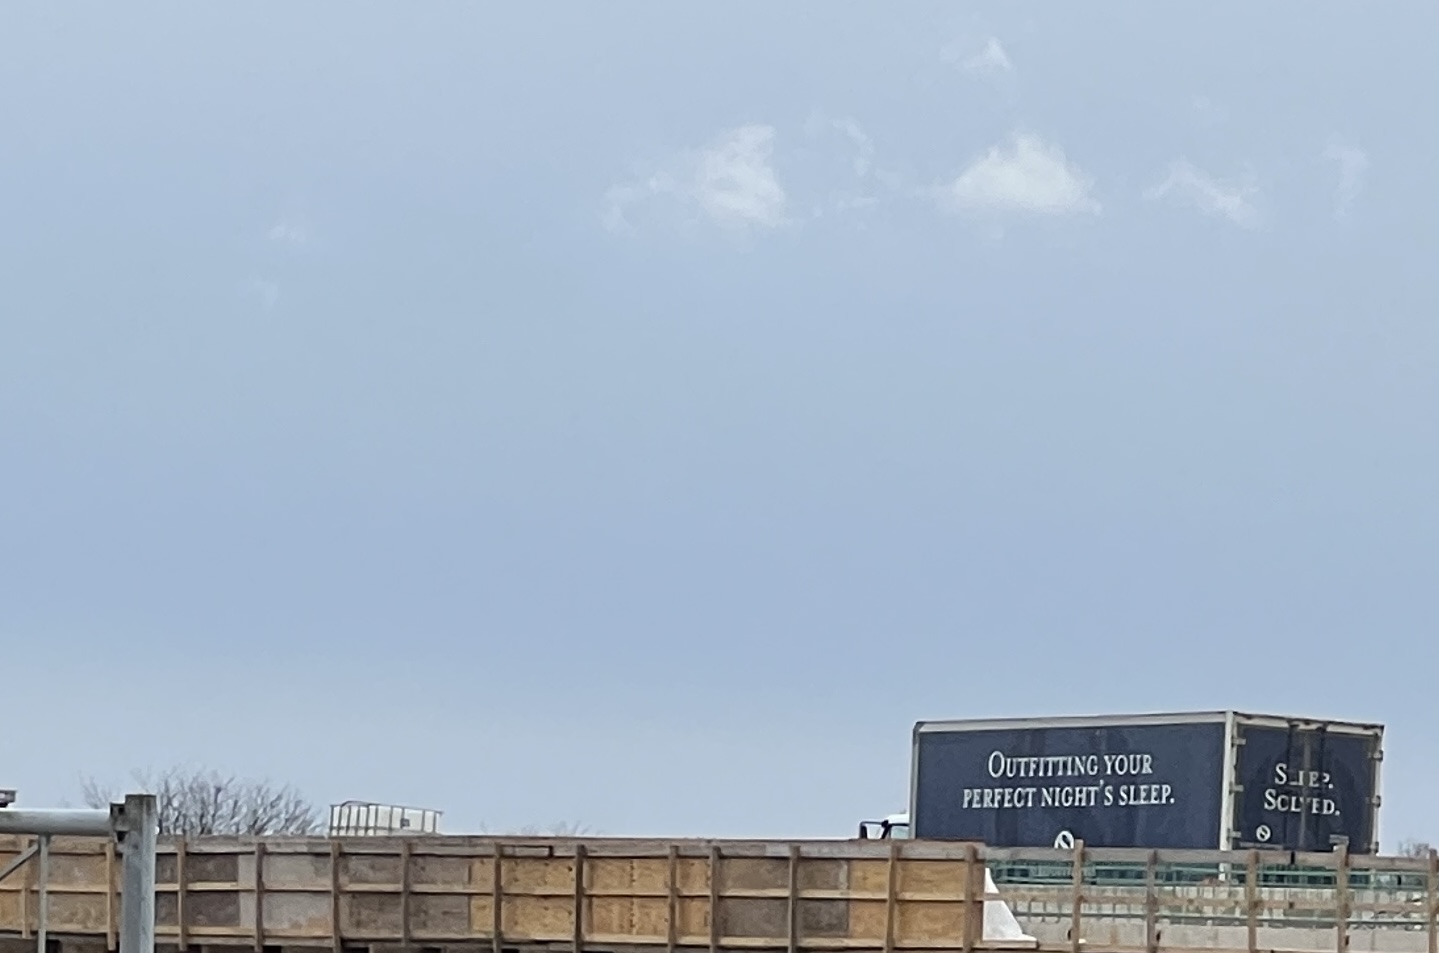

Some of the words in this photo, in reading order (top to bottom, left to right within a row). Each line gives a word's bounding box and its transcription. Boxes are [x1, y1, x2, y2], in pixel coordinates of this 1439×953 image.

[988, 751, 1098, 778] OUTFITTING
[1103, 754, 1153, 776] YOUR
[962, 786, 1037, 808] PERFECT
[1040, 779, 1114, 807] NIGHT'S
[1118, 784, 1175, 806] SLEEP.
